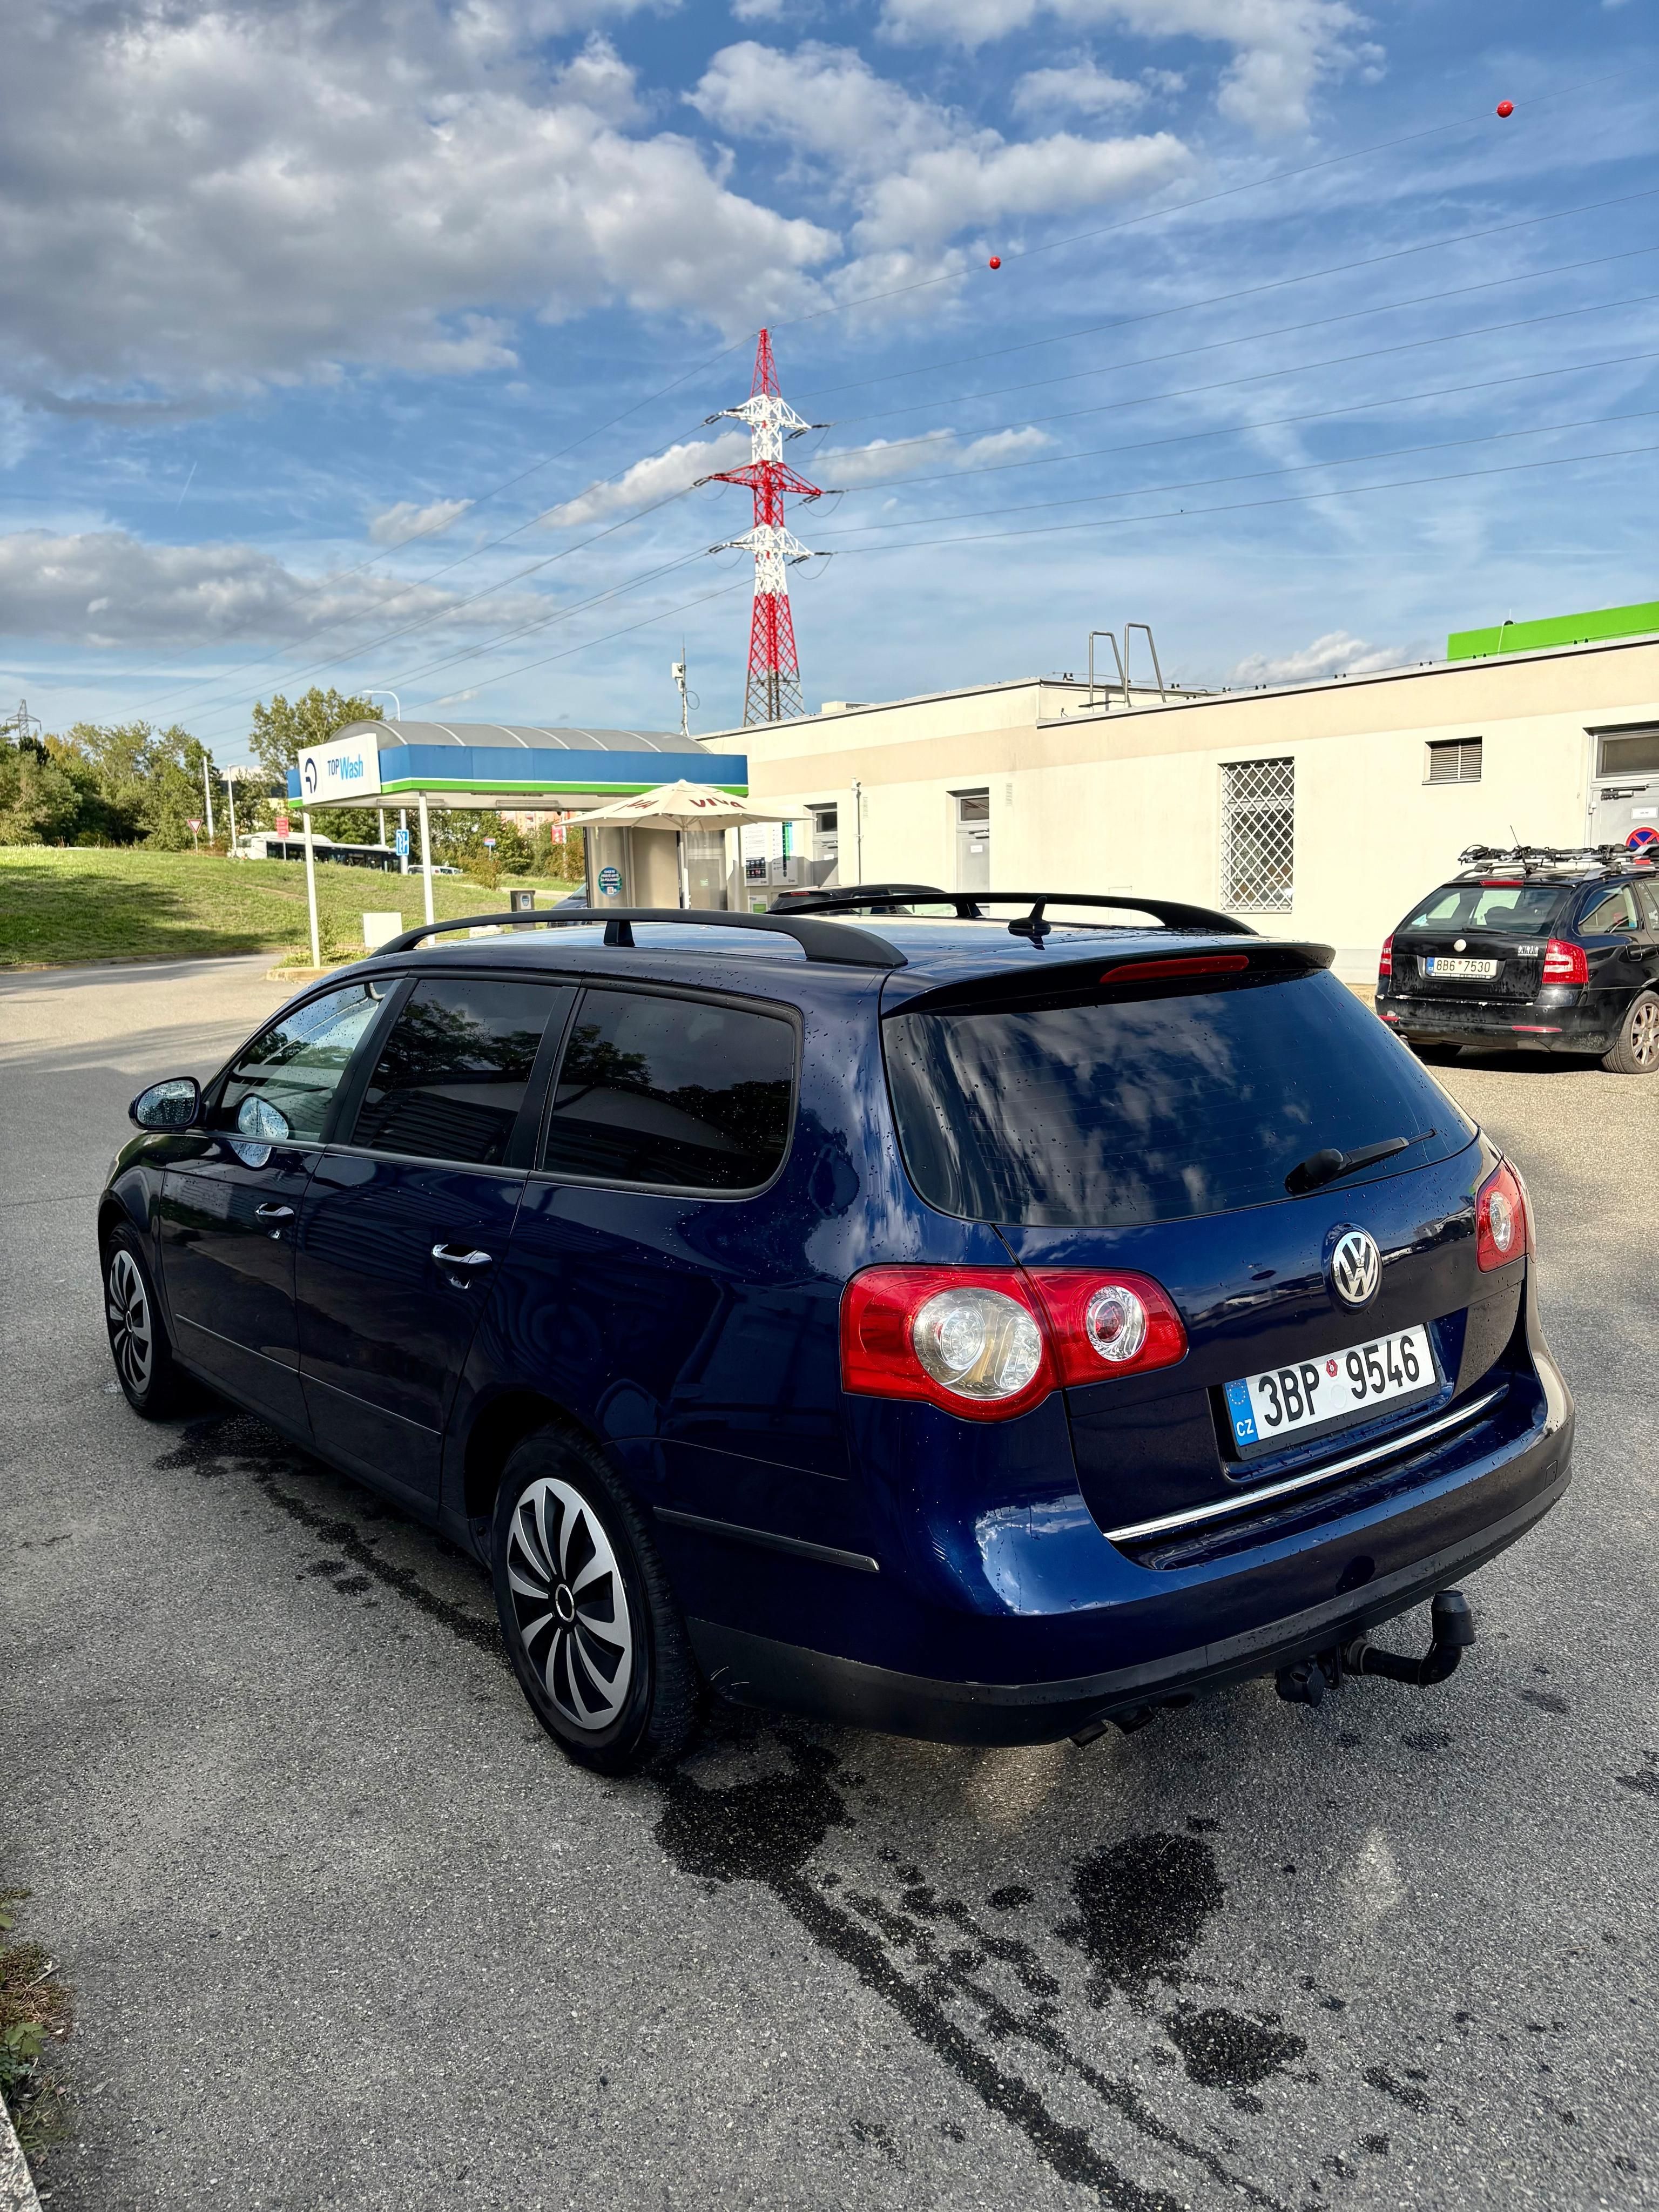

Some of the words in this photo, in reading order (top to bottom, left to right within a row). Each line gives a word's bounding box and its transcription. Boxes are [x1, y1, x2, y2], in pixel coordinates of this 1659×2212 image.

[1437, 960, 1455, 972] 8B6
[1464, 961, 1491, 973] 7530
[1258, 1364, 1319, 1427] 3BP
[1345, 1336, 1420, 1400] 9546
[1236, 1419, 1254, 1437] CZ
